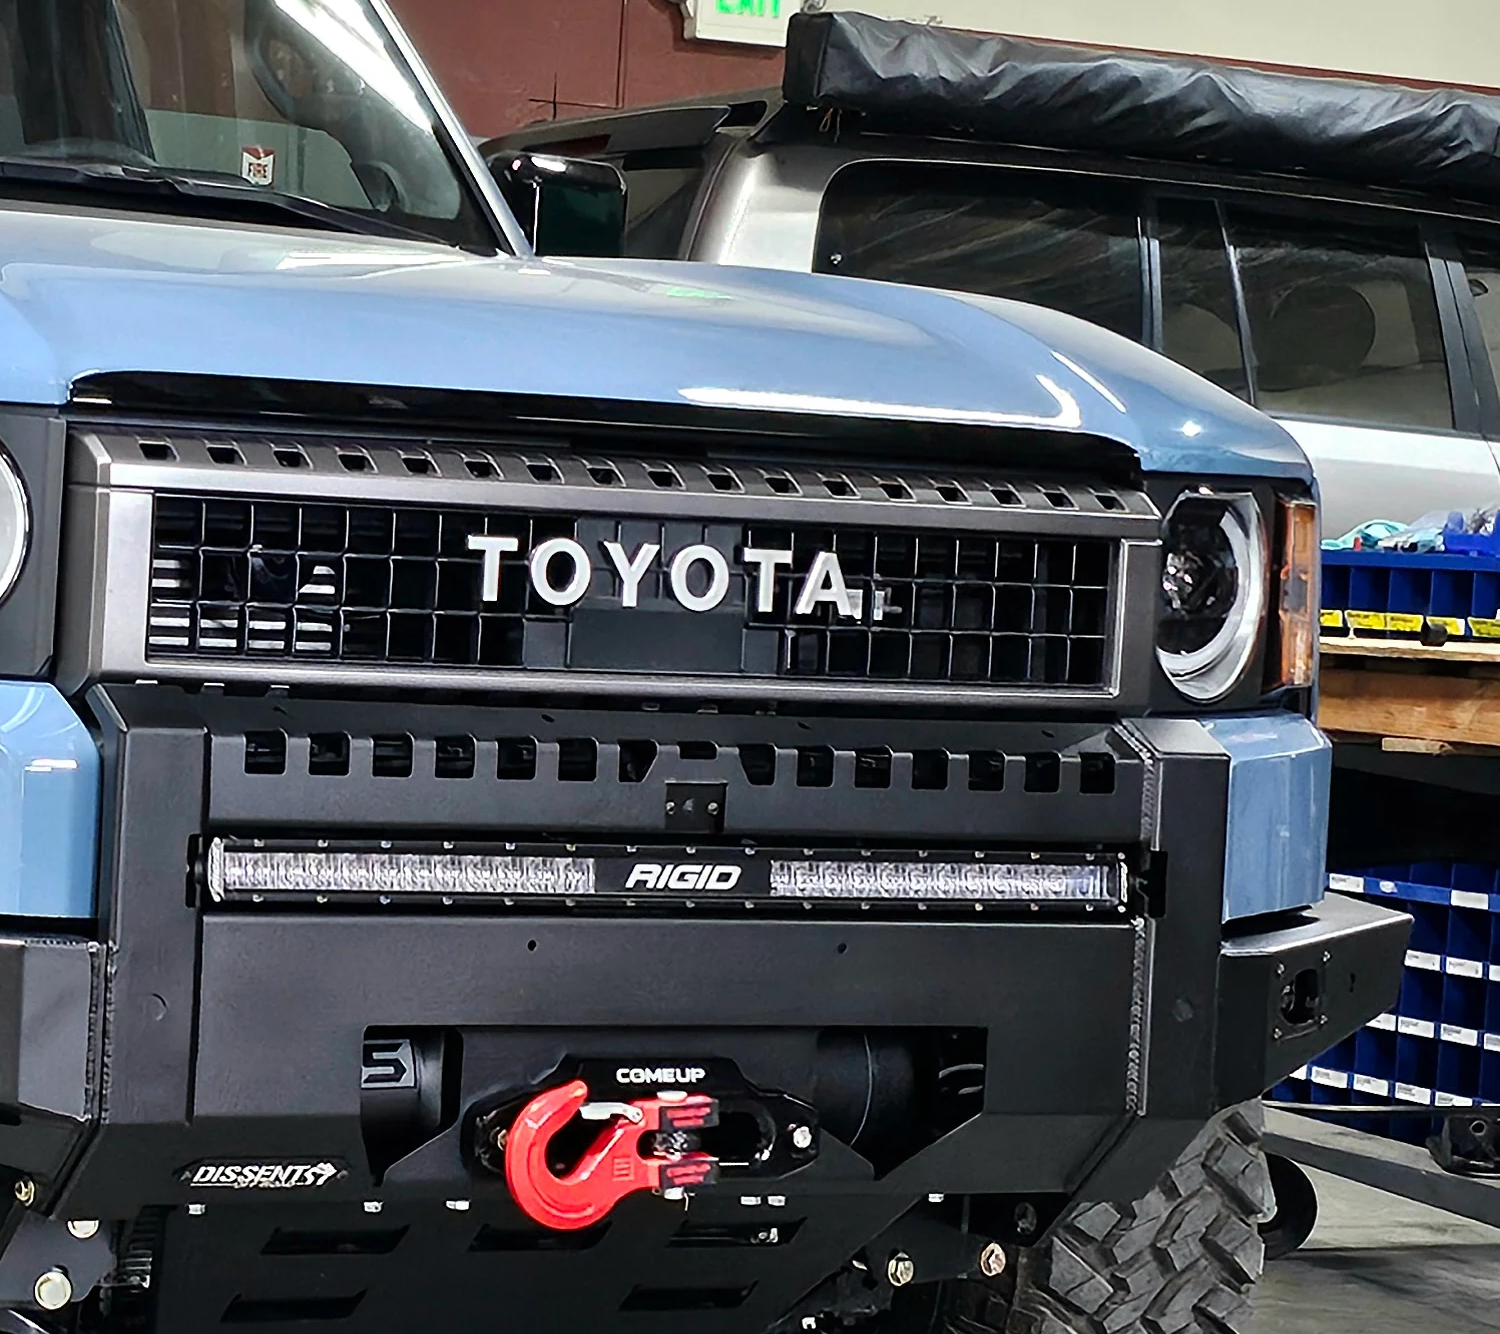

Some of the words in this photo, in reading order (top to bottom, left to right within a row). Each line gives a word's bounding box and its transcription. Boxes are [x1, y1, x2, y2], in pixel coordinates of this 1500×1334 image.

[467, 534, 855, 617] TOYOTA
[625, 863, 742, 891] RIGID
[616, 1067, 706, 1084] COMEUP
[192, 1165, 312, 1185] DISSENT
